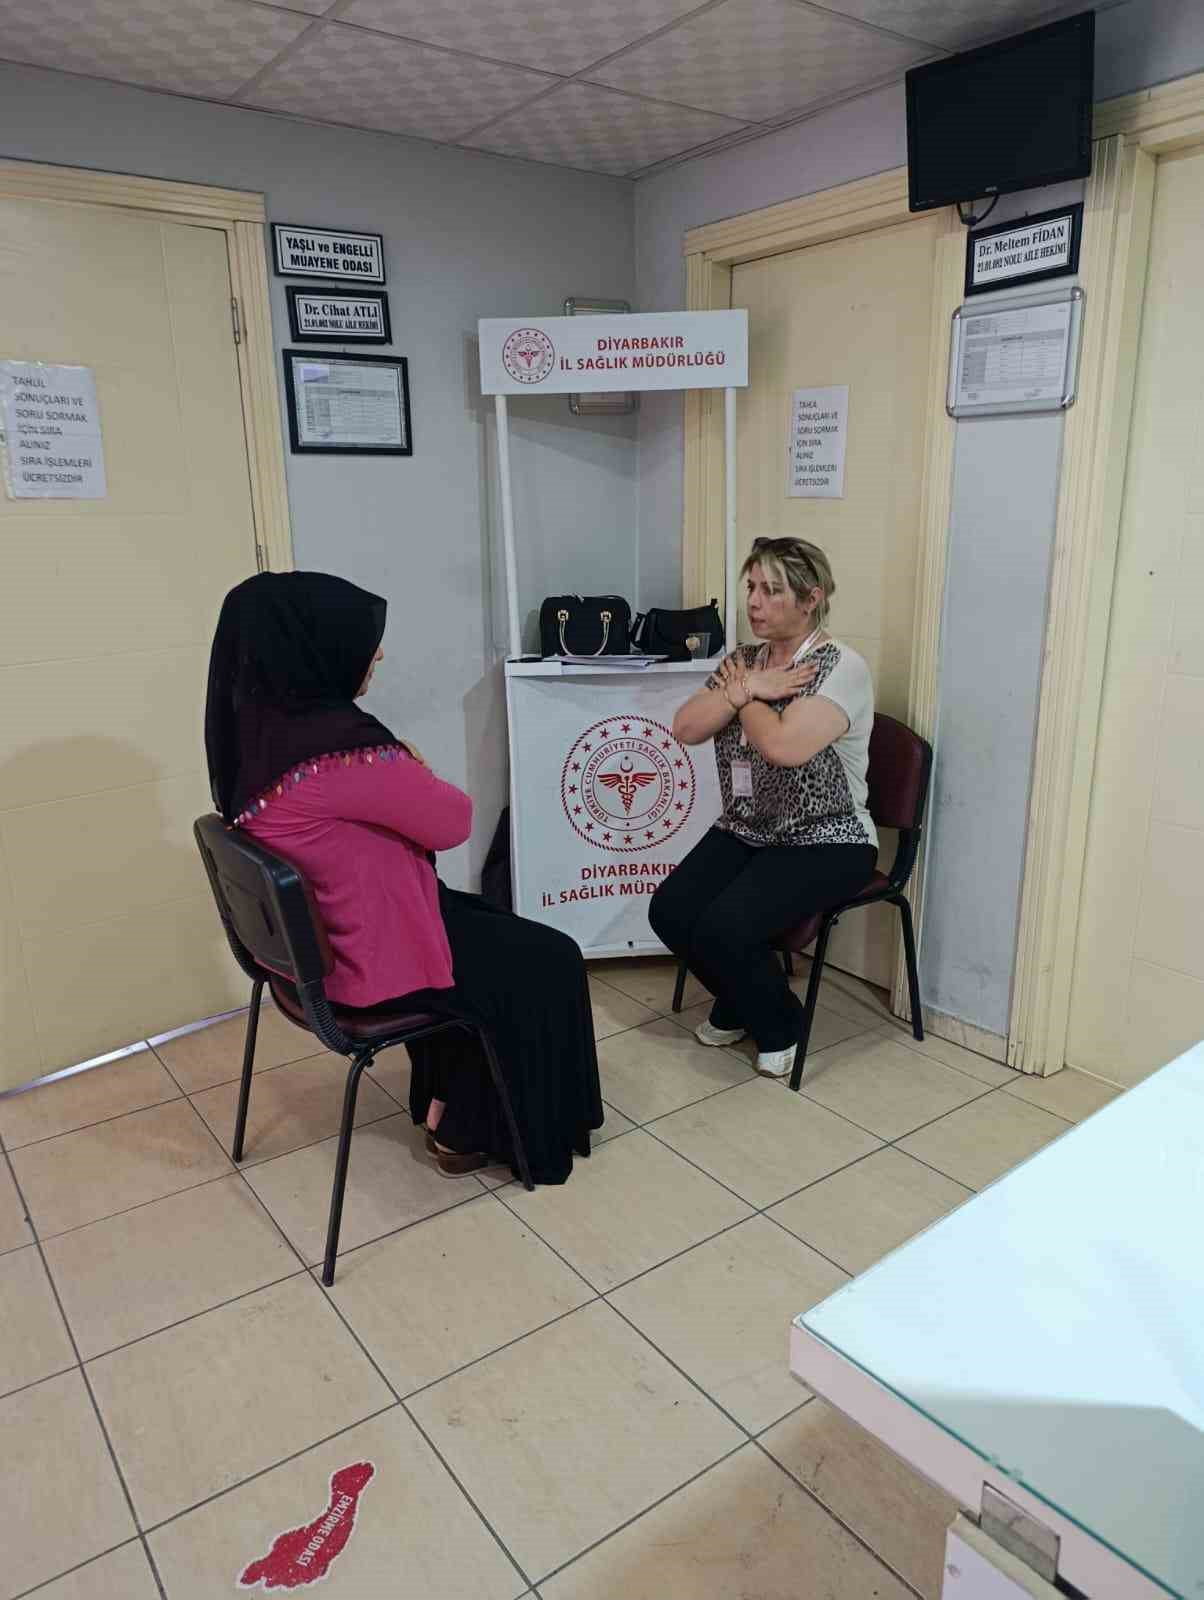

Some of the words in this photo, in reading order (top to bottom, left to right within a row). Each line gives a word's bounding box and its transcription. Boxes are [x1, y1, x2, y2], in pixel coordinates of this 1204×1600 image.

[286, 237, 315, 253] YAŞLI
[318, 243, 329, 252] ve
[333, 242, 373, 257] ENGELLİ
[979, 245, 992, 257] Dr.
[994, 237, 1030, 253] Meltem
[1032, 226, 1064, 244] FİDAN
[290, 254, 340, 270] MUAYENE
[342, 261, 373, 273] ODASI
[304, 303, 320, 315] Dr.
[322, 304, 350, 316] Cihat
[597, 336, 684, 351] DİYARBAKIR
[560, 356, 573, 370] İL
[577, 355, 627, 370] SAĞLIK
[632, 351, 726, 369] MÜDÜRLÜĞÜ
[542, 892, 556, 907] İL
[560, 883, 614, 904] SAĞLIK
[296, 1536, 325, 1567] ODASI
